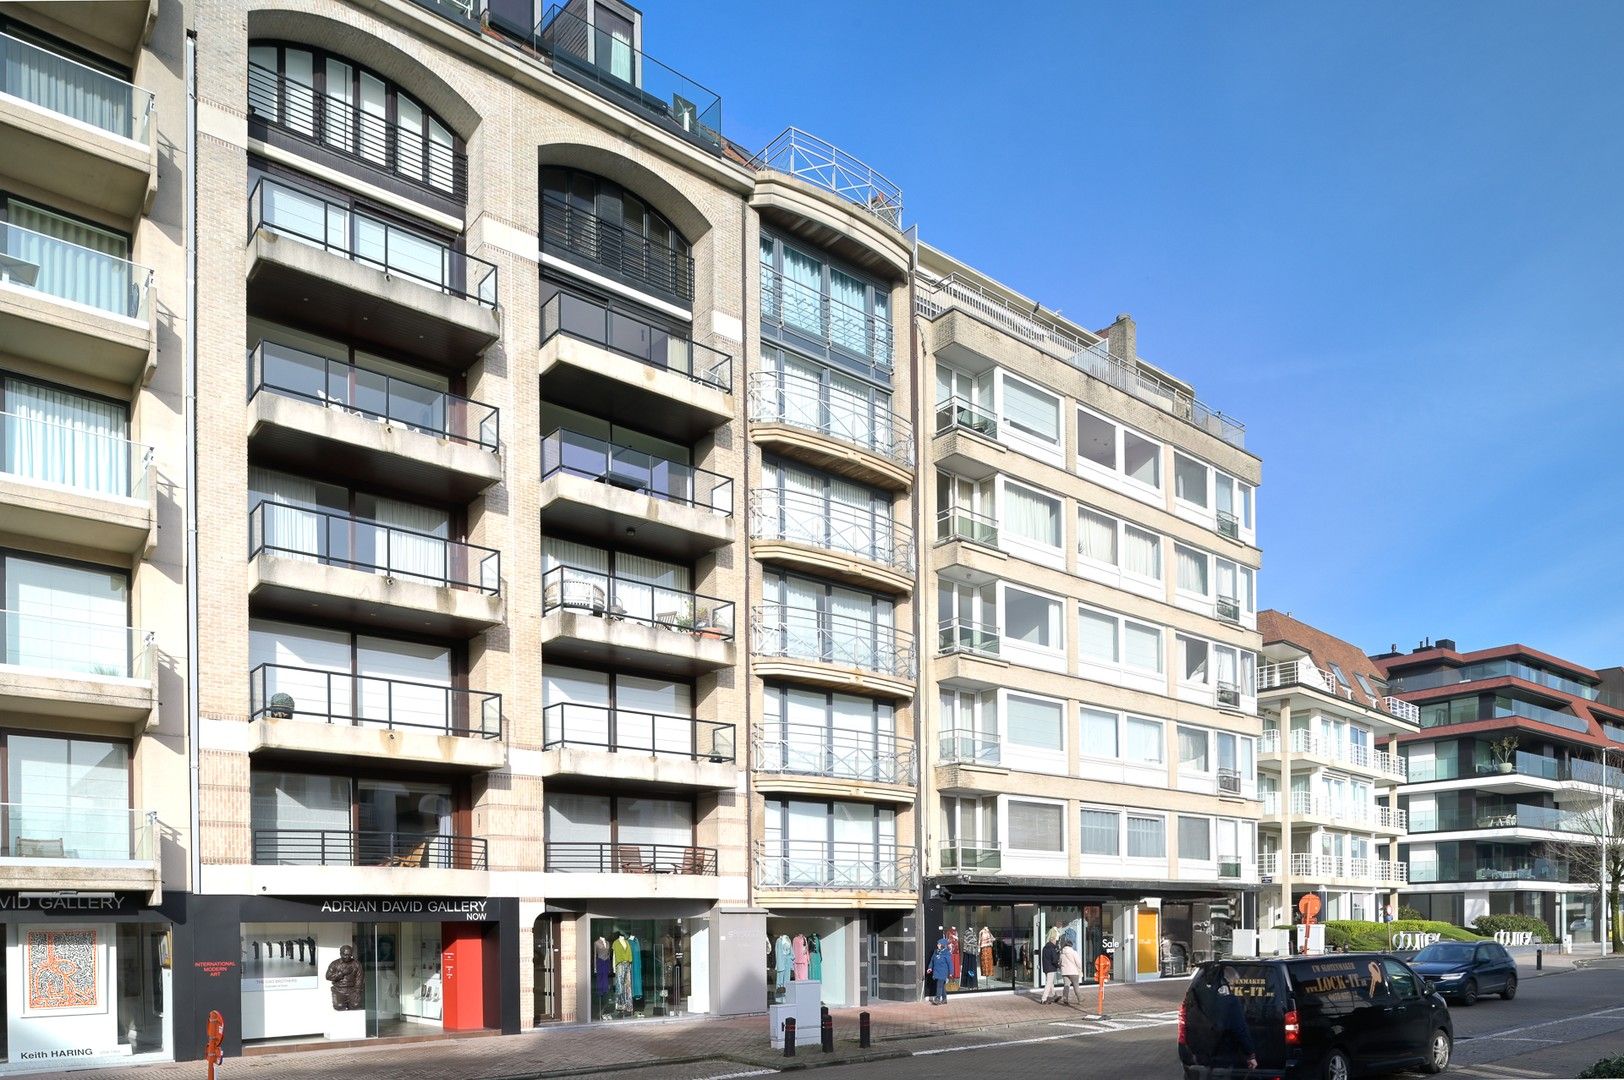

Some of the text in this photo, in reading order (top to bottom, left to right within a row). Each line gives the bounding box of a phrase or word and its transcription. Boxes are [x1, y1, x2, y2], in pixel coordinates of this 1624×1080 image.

[38, 896, 125, 909] GALLERY
[321, 901, 487, 912] ADRIAN DAVID GALLERY
[466, 913, 487, 921] NOW
[1102, 938, 1120, 948] Sale
[20, 1051, 48, 1060] Keith
[51, 1048, 93, 1058] HARING
